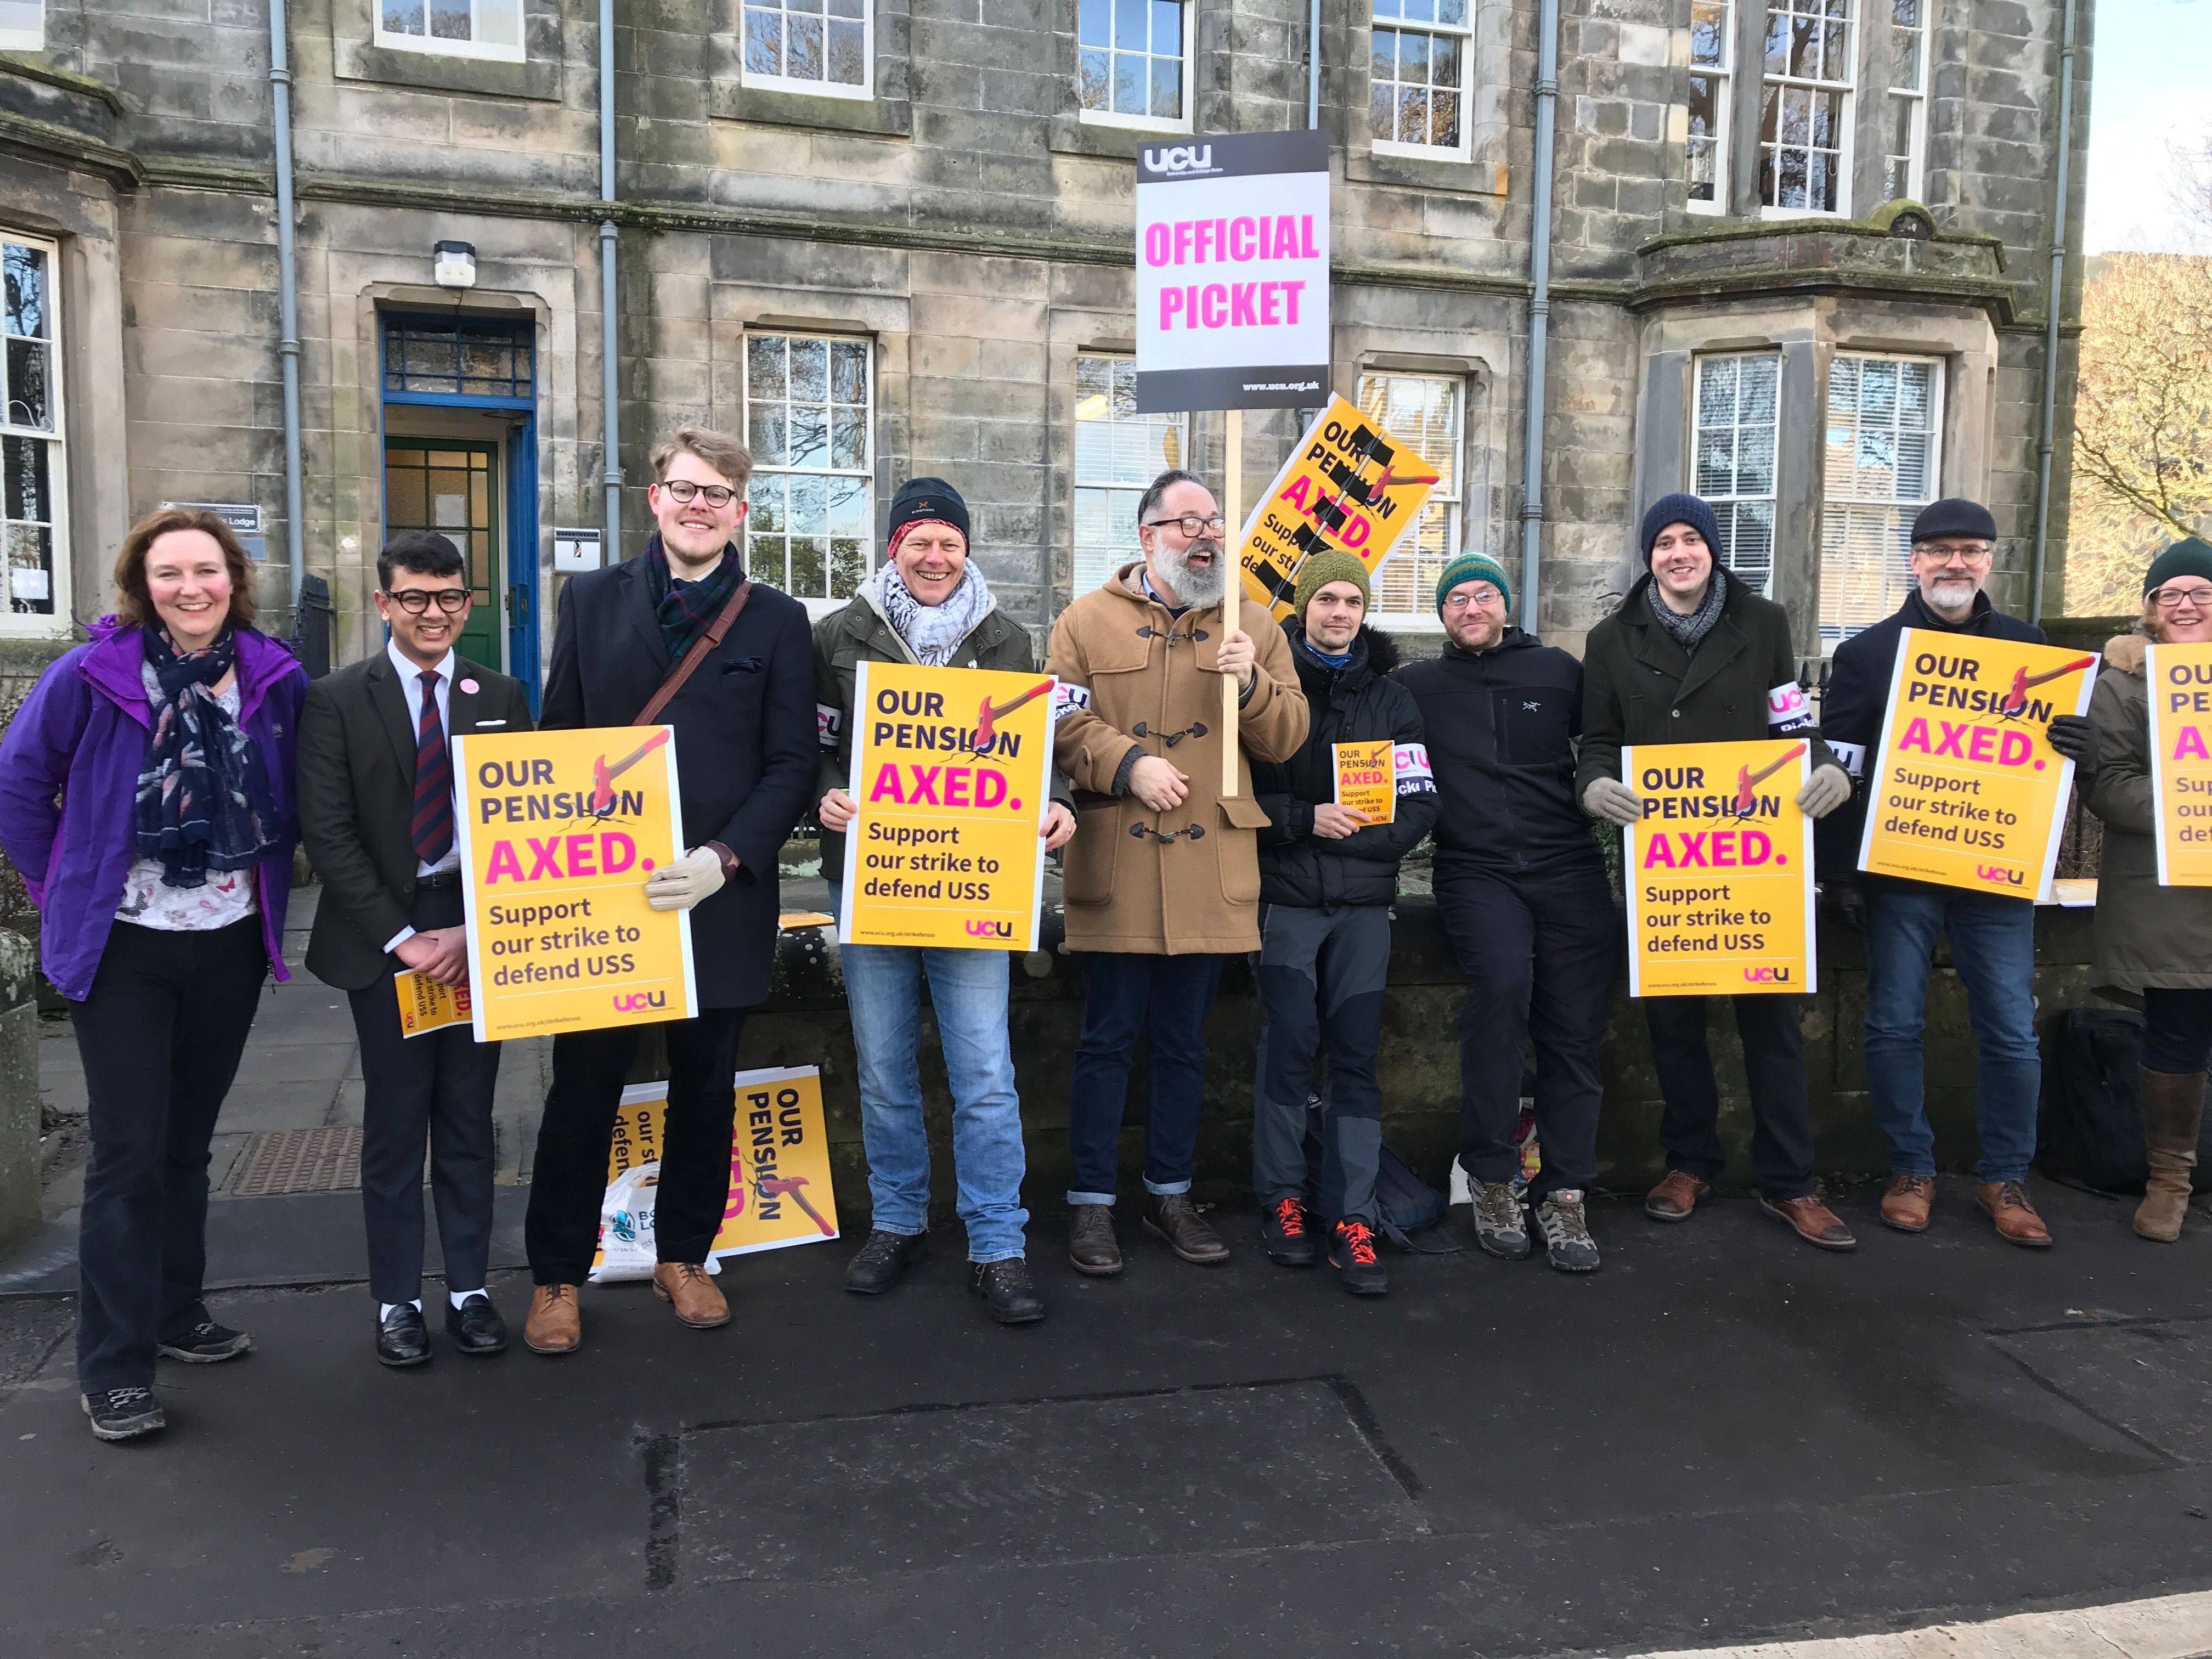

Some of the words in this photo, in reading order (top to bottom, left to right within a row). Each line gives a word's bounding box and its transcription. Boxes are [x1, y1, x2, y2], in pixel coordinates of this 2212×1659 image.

[1146, 214, 1321, 267] OFFICIAL
[1160, 280, 1306, 330] PICKET
[1243, 381, 1319, 391] www.ucu.org.uk
[229, 517, 256, 527] Lodge
[1252, 536, 1279, 557] our
[1915, 653, 1979, 682] OUR
[2170, 664, 2212, 685] OU
[877, 689, 944, 718] OUR
[1908, 681, 2053, 723] PENSION
[874, 722, 1022, 758] PENSION
[1898, 717, 2046, 771] AXED.
[1340, 750, 1360, 758] OUR
[1340, 759, 1385, 768] PENSION
[479, 759, 555, 788] OUR
[869, 763, 1022, 810] AXED.
[1341, 771, 1387, 785] AXED.
[1643, 767, 1705, 790] OUR
[1893, 768, 1981, 795] Support
[481, 791, 644, 824] PENSION
[1643, 795, 1780, 819] PENSION
[1889, 795, 1926, 811] our
[1929, 797, 1990, 820] strike
[1995, 808, 2017, 825] to
[868, 822, 960, 847] Support
[1885, 816, 1958, 842] defend
[1963, 828, 2005, 849] USS
[484, 832, 654, 884] AXED.
[866, 854, 905, 870] our
[910, 853, 972, 872] strike
[977, 856, 999, 873] to
[1643, 831, 1787, 869] AXED.
[864, 878, 941, 899] defend
[948, 882, 990, 901] USS
[1646, 885, 1730, 905] Support
[489, 899, 591, 927] Support
[1646, 913, 1681, 927] our
[1686, 909, 1744, 926] strike
[1750, 911, 1771, 924] to
[492, 938, 535, 955] our
[540, 927, 610, 952] strike
[616, 925, 640, 943] to
[1647, 934, 1718, 952] defend
[1724, 934, 1764, 950] USS
[494, 958, 580, 986] defend
[587, 953, 635, 977] USS
[414, 974, 425, 1000] defend
[427, 986, 437, 1006] strike
[437, 984, 447, 1000] port
[419, 1001, 427, 1016] USS
[637, 1111, 653, 1144] our
[777, 1088, 803, 1147] OUR
[747, 1092, 781, 1220] PENSION
